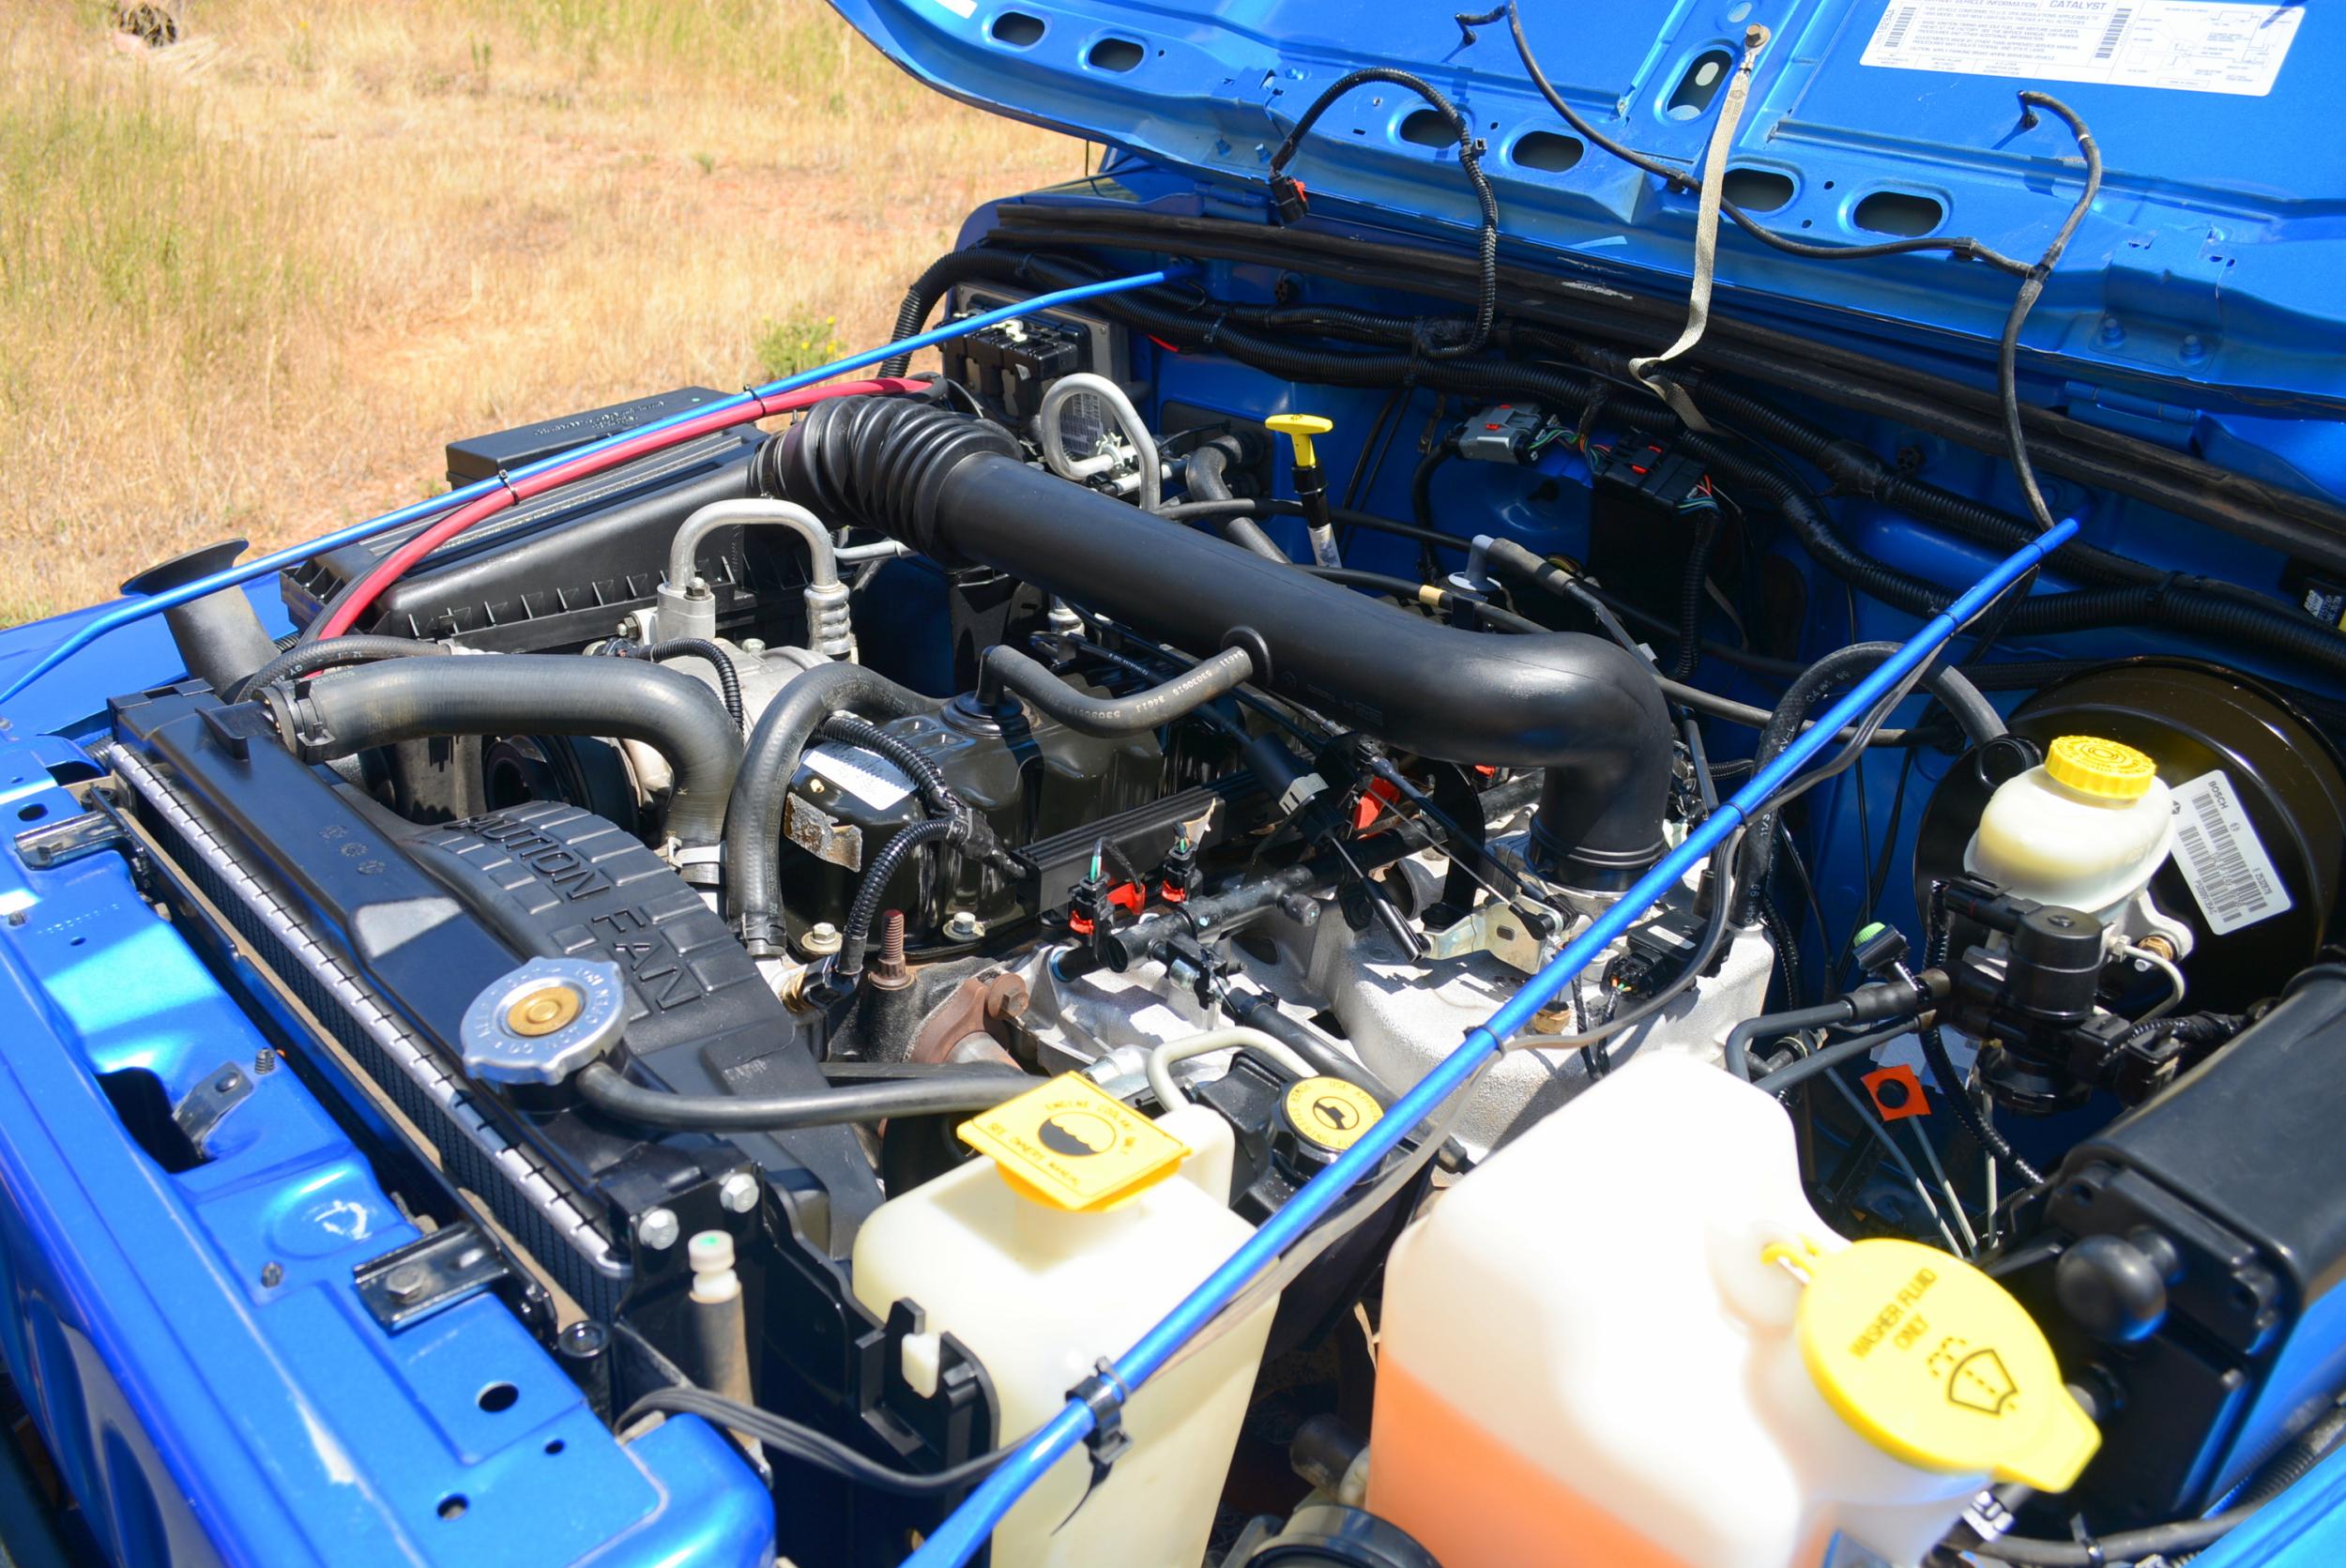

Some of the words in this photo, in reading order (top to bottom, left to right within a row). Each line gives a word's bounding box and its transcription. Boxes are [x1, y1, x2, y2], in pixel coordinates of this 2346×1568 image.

[2049, 0, 2108, 9] CATALYST
[2208, 781, 2229, 810] BOSCH
[590, 908, 703, 1012] FAN
[1045, 1101, 1089, 1110] ENGINE
[1851, 1304, 1904, 1360] WASHER
[1898, 1268, 1937, 1307] FLUID
[1894, 1313, 1928, 1349] ONLY
